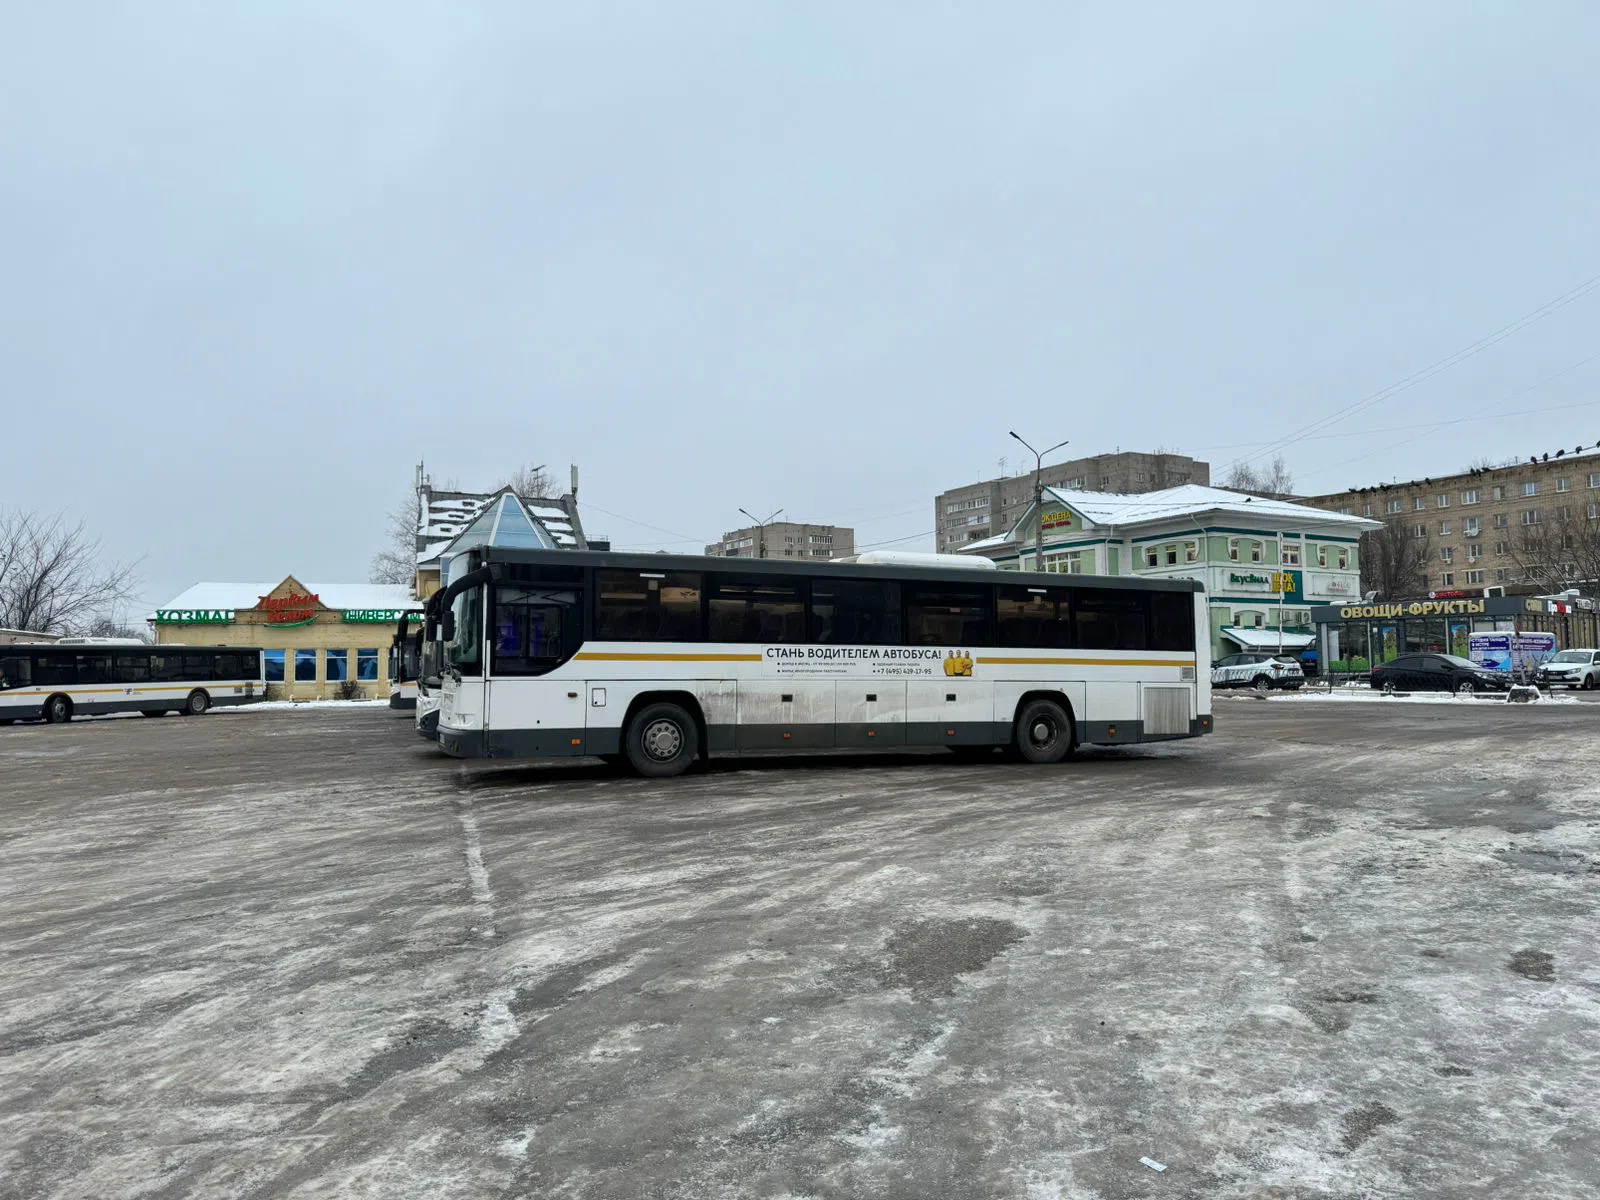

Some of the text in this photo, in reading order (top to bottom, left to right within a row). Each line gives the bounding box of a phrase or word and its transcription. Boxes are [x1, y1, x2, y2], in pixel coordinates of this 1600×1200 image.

[155, 609, 234, 625] ХОЗМАГ
[1340, 599, 1485, 619] ОВОЩИ-ФРУКТЫ
[766, 648, 942, 660] СТАНЬ ВОДИТЕЛЕМ АВТОБУСА!
